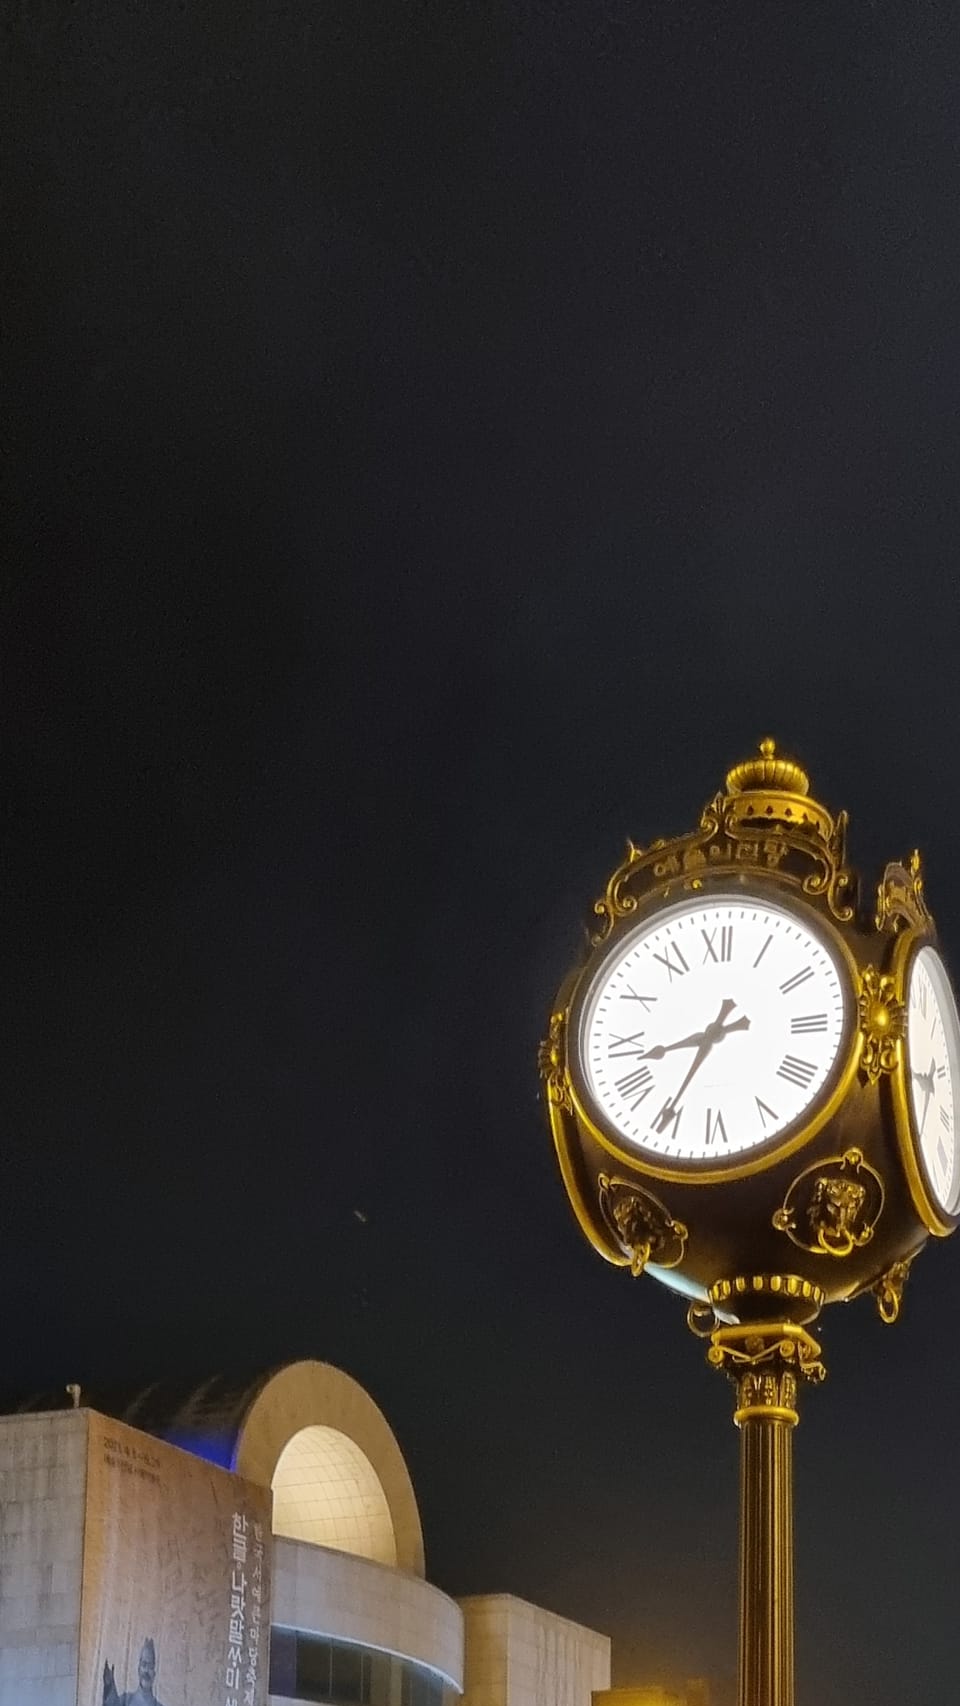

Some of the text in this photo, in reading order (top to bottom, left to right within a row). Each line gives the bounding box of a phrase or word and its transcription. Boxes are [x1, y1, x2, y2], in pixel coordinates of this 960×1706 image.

[653, 941, 690, 983] XI
[701, 925, 733, 965] XII
[753, 934, 773, 968] I
[779, 966, 815, 995] II
[620, 984, 658, 1013] X
[791, 1013, 828, 1034] III
[608, 1032, 645, 1058] IX
[776, 1054, 819, 1089] IIII
[614, 1066, 656, 1112] VIII
[650, 1096, 684, 1140] VI
[705, 1107, 728, 1145] VI
[754, 1095, 779, 1128] V
